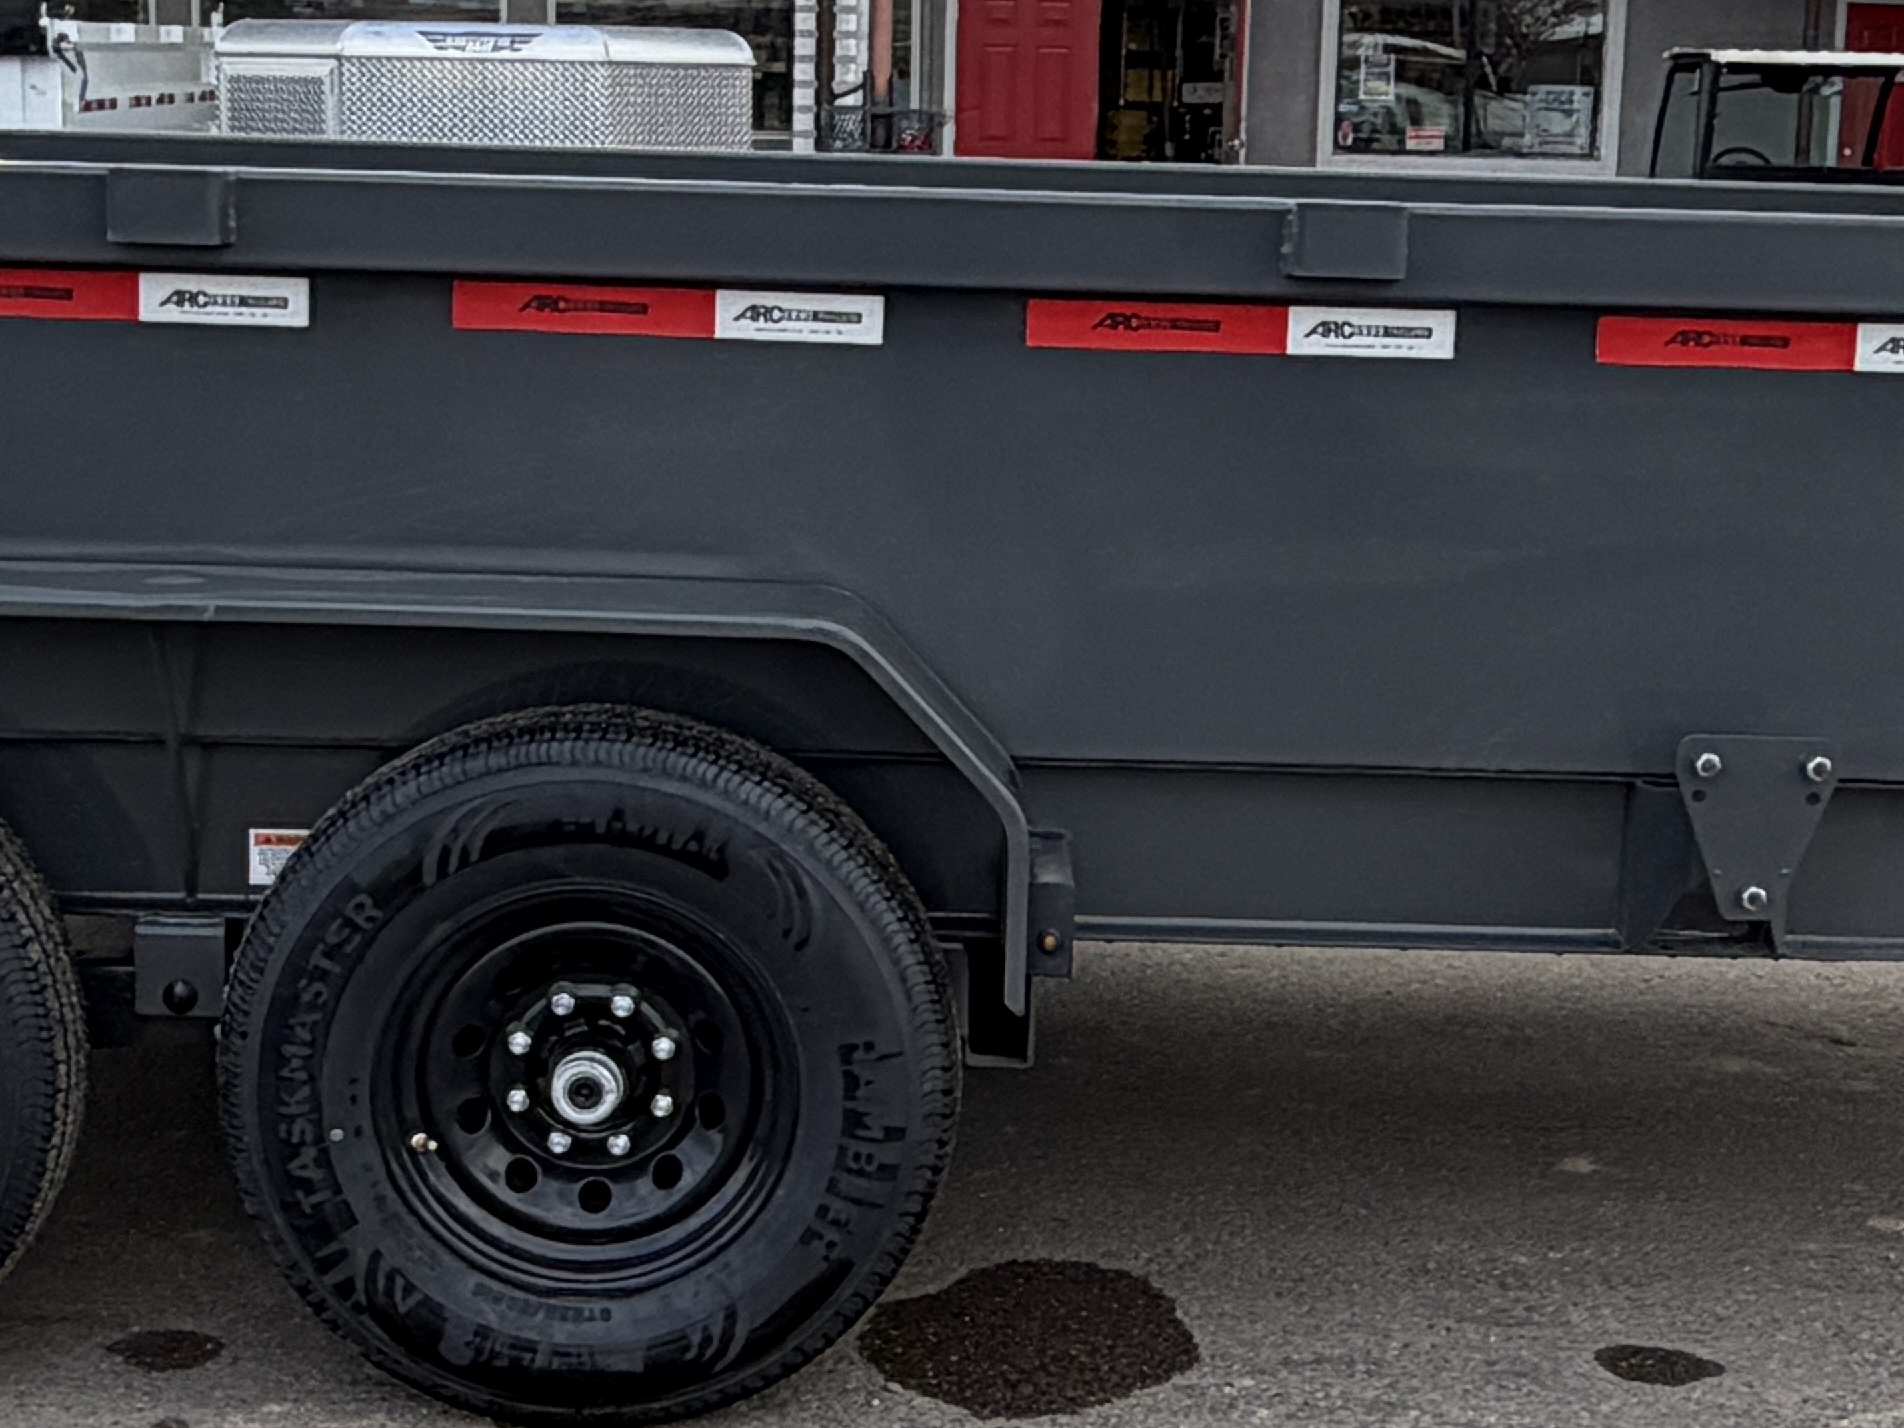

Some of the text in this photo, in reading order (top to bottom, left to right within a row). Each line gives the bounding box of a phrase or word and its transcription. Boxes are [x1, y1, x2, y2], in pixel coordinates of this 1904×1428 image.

[159, 289, 209, 308] ARC
[519, 295, 566, 314] ARC
[734, 304, 783, 324] ARC
[1092, 312, 1141, 332] ARC
[1304, 320, 1354, 340] ARC
[1664, 329, 1715, 348] ARC
[276, 892, 384, 1214] TASKMASTER
